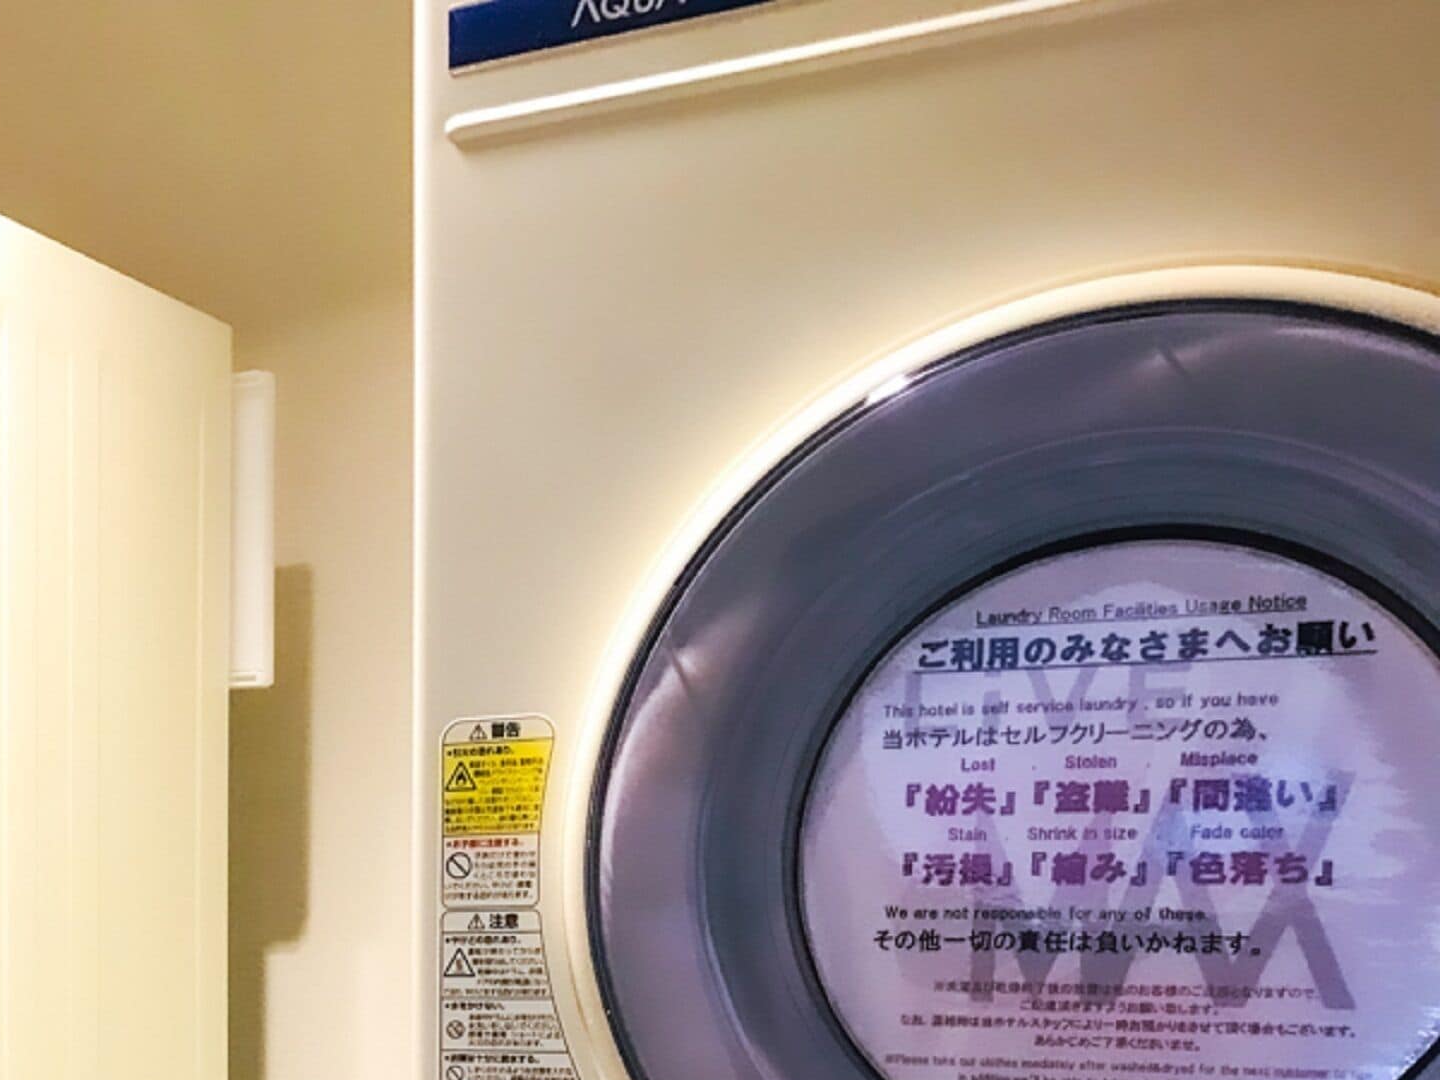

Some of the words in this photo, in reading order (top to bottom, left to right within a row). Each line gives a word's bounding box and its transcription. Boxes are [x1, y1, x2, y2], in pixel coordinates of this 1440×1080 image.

[975, 609, 1043, 628] Laundry
[1048, 605, 1097, 622] Room
[1103, 602, 1179, 619] Facilities
[1185, 597, 1242, 617] Usage
[1249, 593, 1308, 612] Notice
[918, 620, 1376, 670] ご利用のみなさまへお願い
[883, 704, 914, 719] This
[918, 703, 959, 718] hotel
[961, 702, 975, 717] is
[980, 701, 1008, 716] self
[1016, 699, 1075, 714] service
[1079, 698, 1139, 715] laundry
[1155, 697, 1175, 710] so
[1179, 694, 1194, 709] if
[1199, 693, 1233, 711] you
[1236, 692, 1279, 708] have
[960, 756, 996, 773] Lost
[1064, 753, 1118, 770] Stolen
[1179, 750, 1259, 769] Misplace
[947, 826, 988, 843] Stain
[1026, 825, 1077, 842] Shrink
[1103, 824, 1139, 842] size
[1189, 823, 1234, 842] Fade
[1240, 823, 1285, 842] color
[489, 912, 519, 929] 注意
[885, 905, 910, 921] We
[913, 907, 939, 921] are
[943, 906, 969, 921] not
[972, 906, 1063, 923] responsible
[1068, 905, 1093, 921] for
[1098, 907, 1127, 924] any
[1133, 905, 1153, 921] of
[871, 929, 1263, 958] その他一切の責任は負いかねます。
